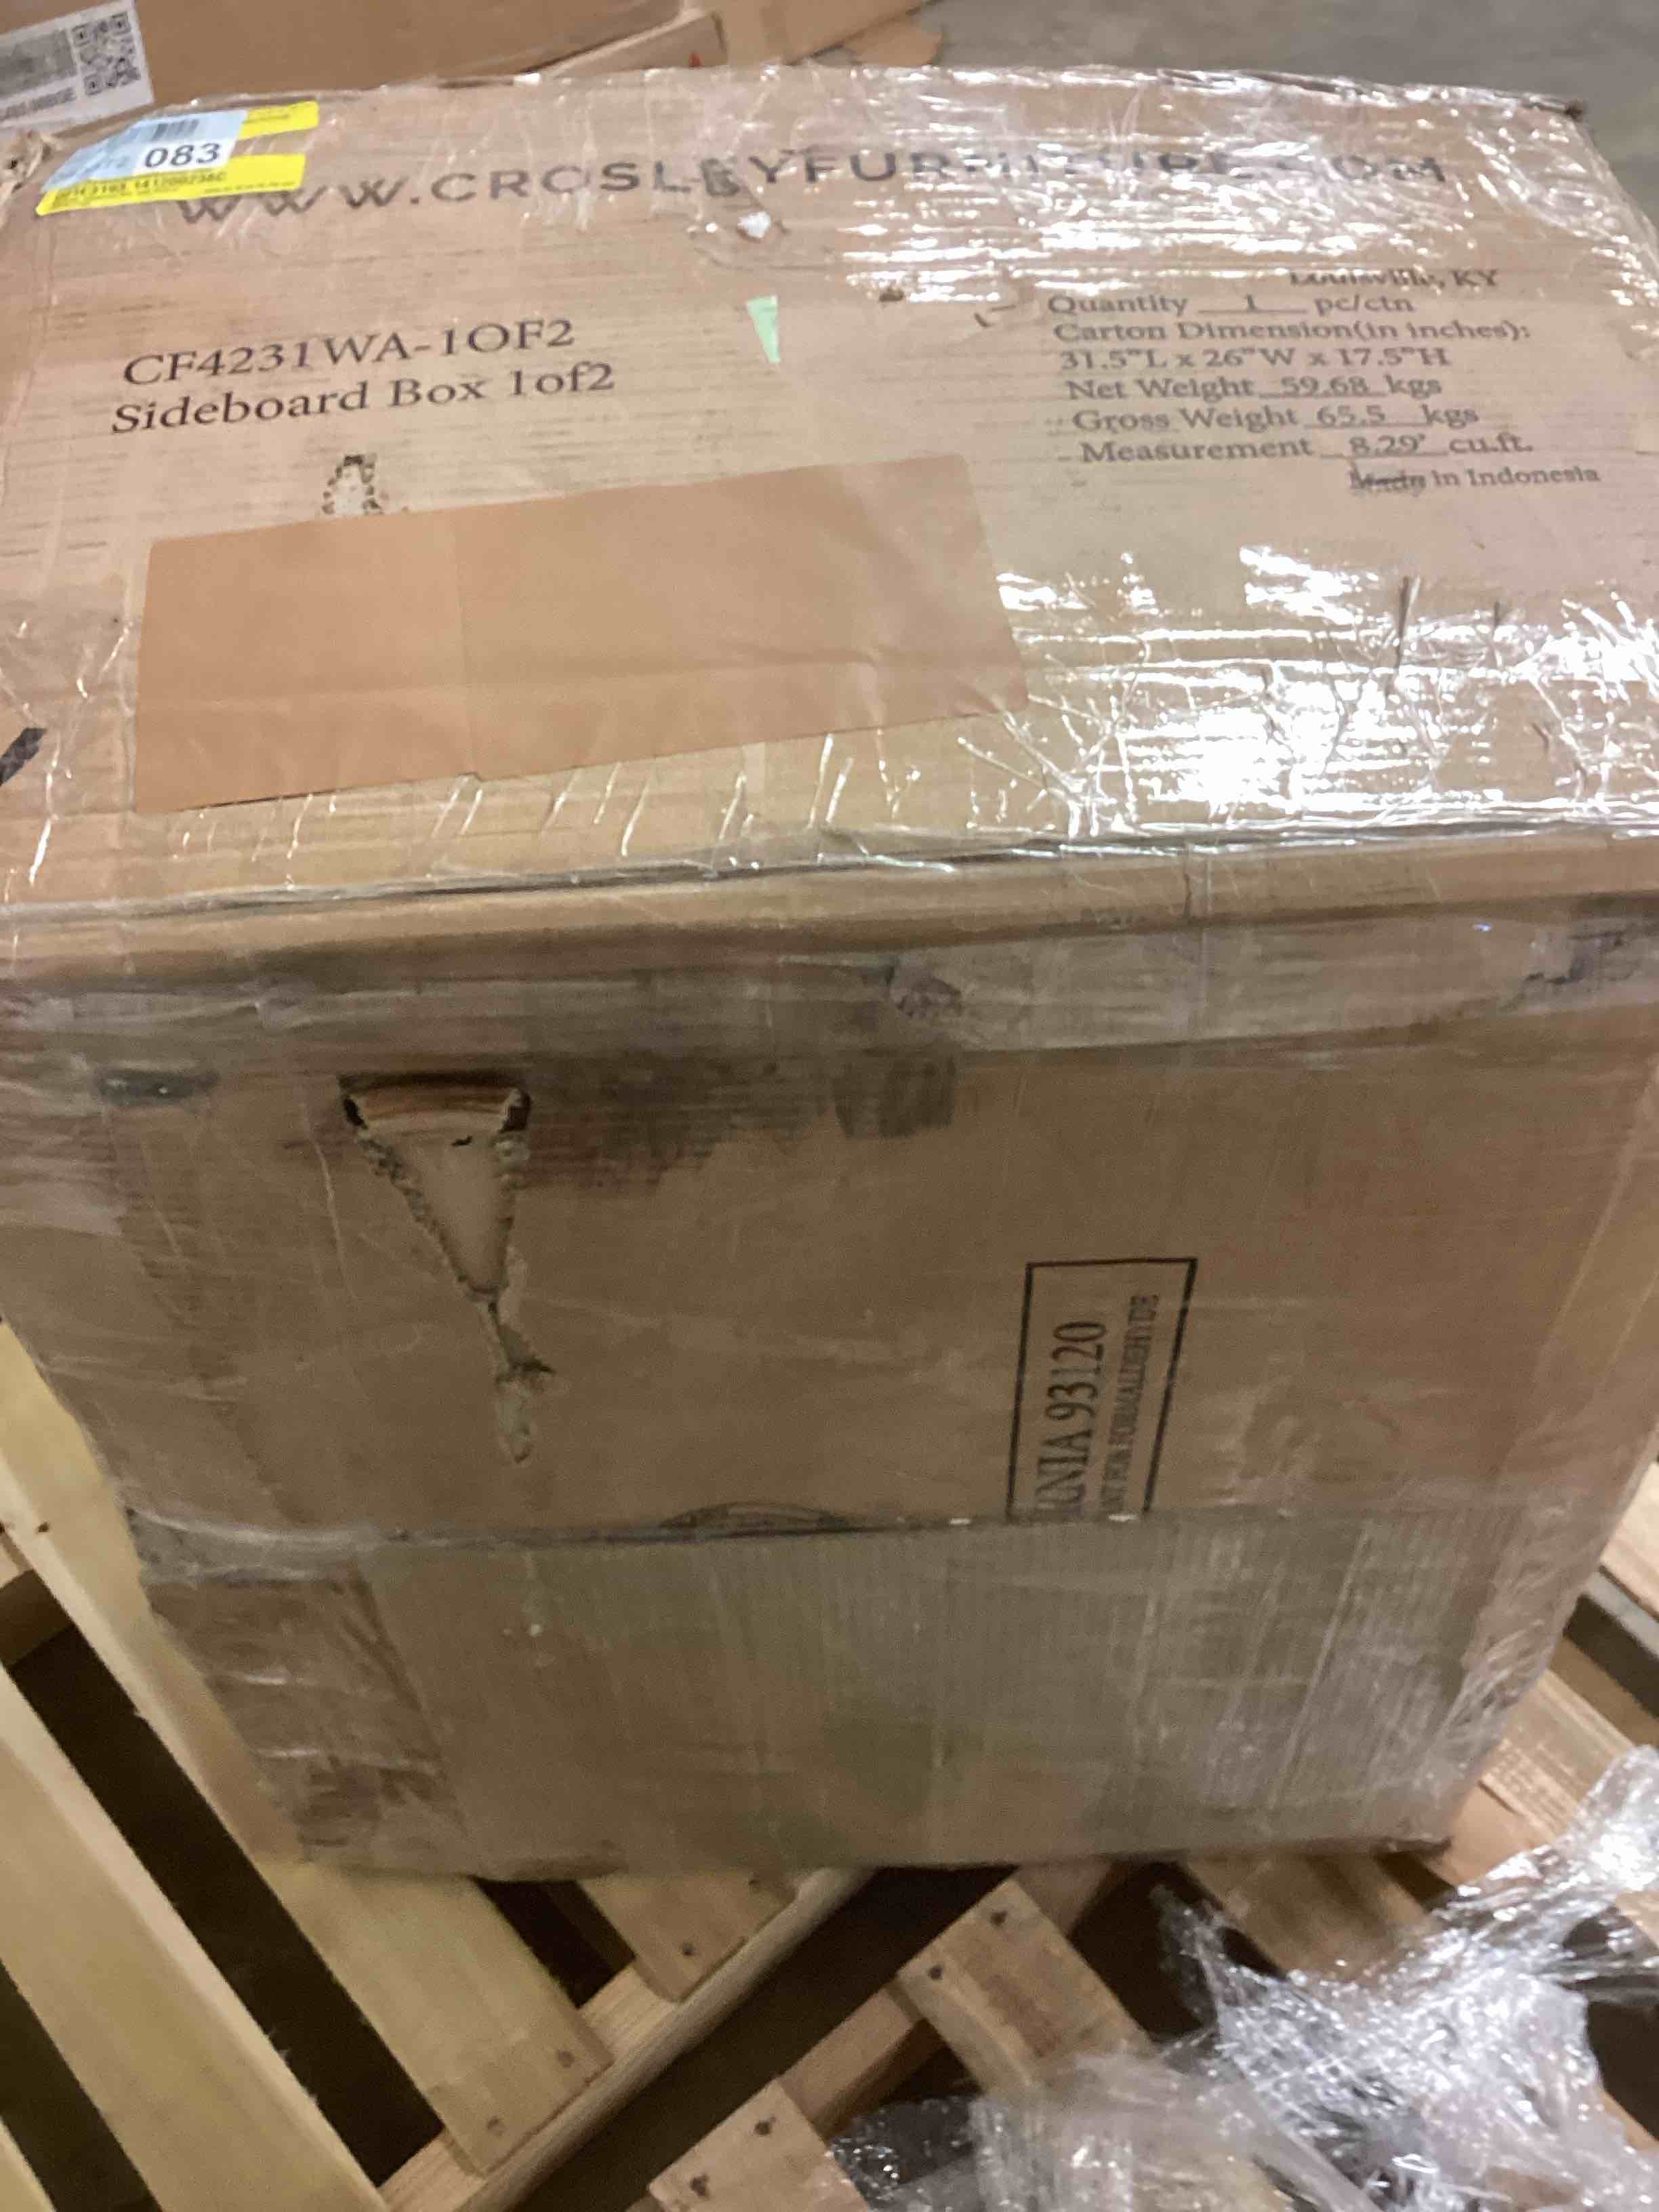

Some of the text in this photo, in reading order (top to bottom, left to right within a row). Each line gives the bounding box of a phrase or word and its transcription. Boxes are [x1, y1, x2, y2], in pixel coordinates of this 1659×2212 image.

[144, 142, 221, 169] 083
[1449, 269, 1498, 285] KY
[1048, 293, 1188, 316] Quantity
[1315, 295, 1415, 316] pc/ctn
[1053, 320, 1531, 340] Carton Dimension(in inches):
[123, 319, 575, 386] CF4231WA-1OF2
[1203, 346, 1296, 368] 26"W
[1339, 346, 1452, 367] 17.5"H
[112, 361, 615, 435] Sideboard Box 1of2
[1065, 379, 1128, 400] Net
[1135, 376, 1254, 403] Weight
[1385, 373, 1443, 400] kgs
[1071, 404, 1480, 434] Gross Weight 65.5 kgs
[1080, 436, 1312, 463] Measurement
[1448, 431, 1534, 454] cu.ft.
[1429, 469, 1460, 487] in
[1465, 465, 1601, 487] Indonesia
[1044, 1321, 1107, 1421] 93120
